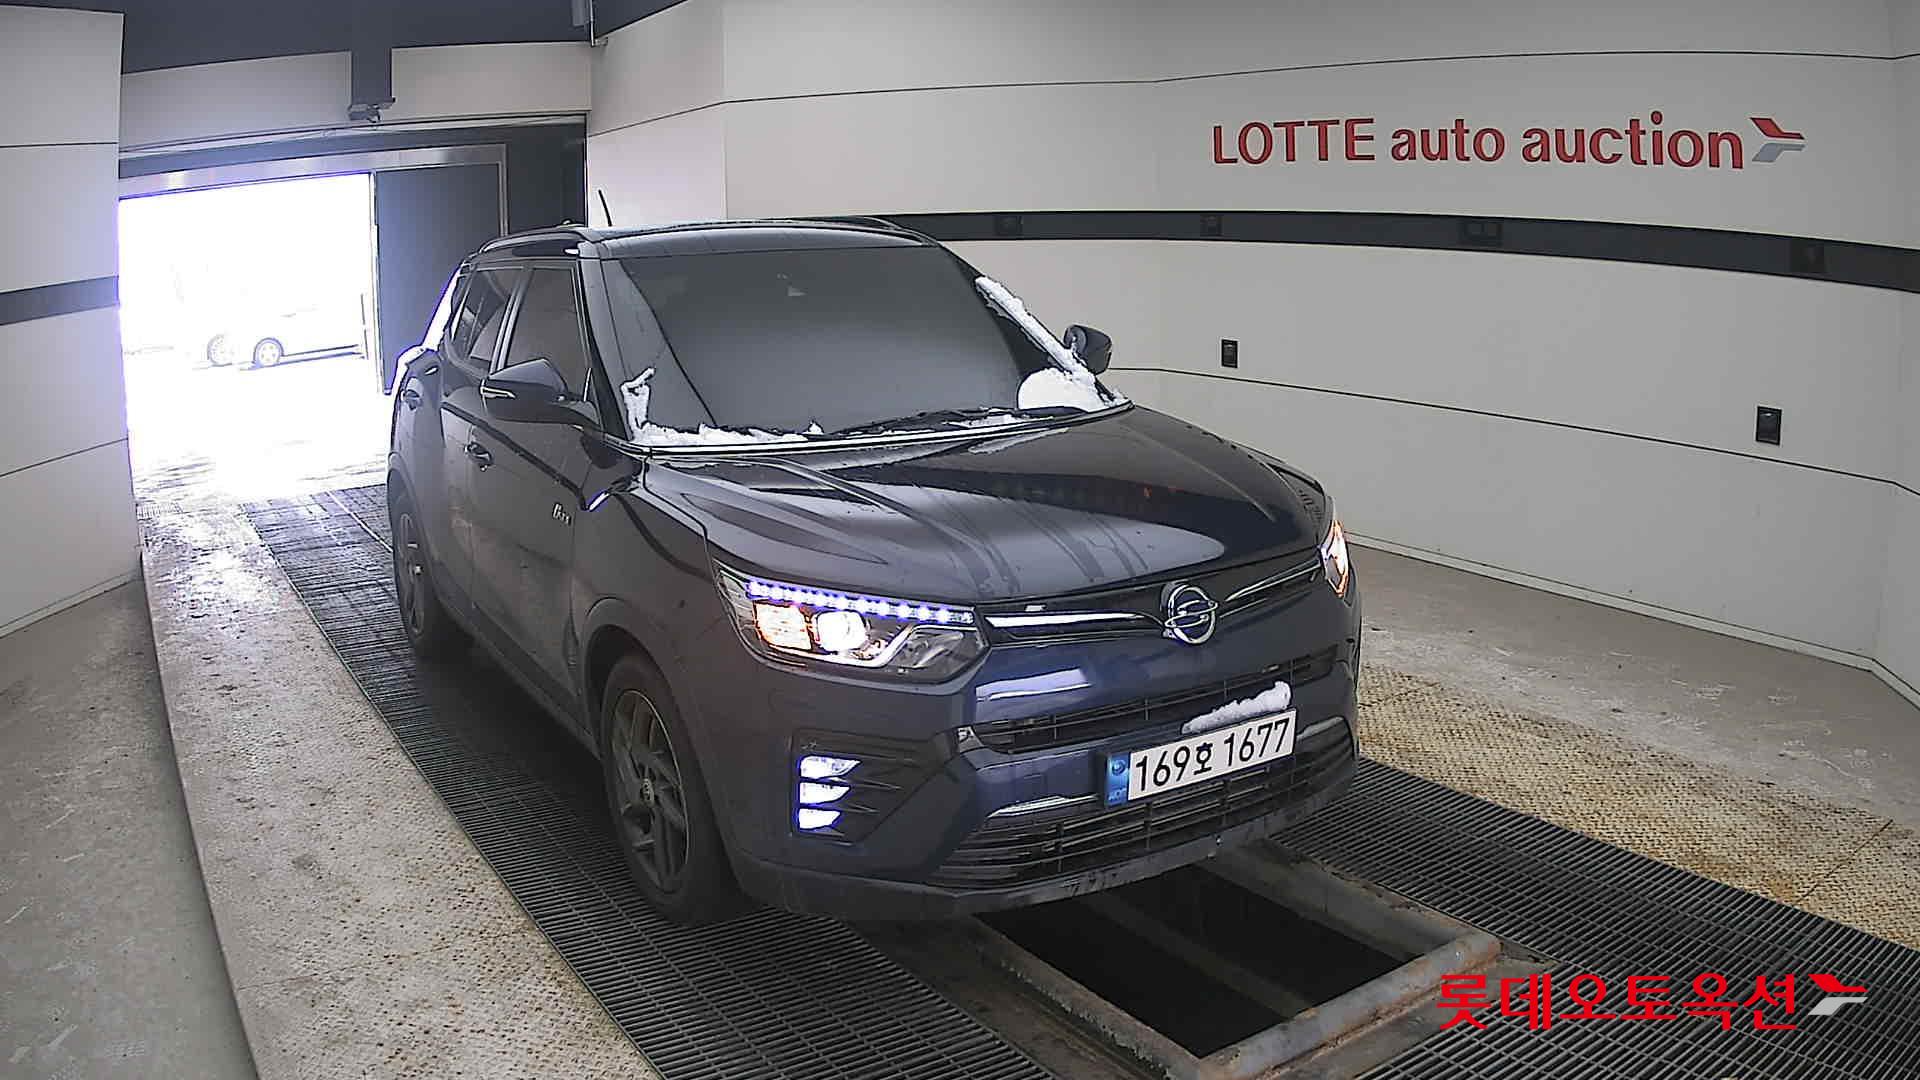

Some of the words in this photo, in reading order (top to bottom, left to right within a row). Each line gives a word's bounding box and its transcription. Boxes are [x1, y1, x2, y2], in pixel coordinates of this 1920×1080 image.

[1213, 117, 1376, 165] LOTTE
[1391, 118, 1506, 162] auto
[1520, 111, 1745, 170] auction
[1136, 742, 1214, 791] 169호
[1223, 717, 1290, 767] 1677
